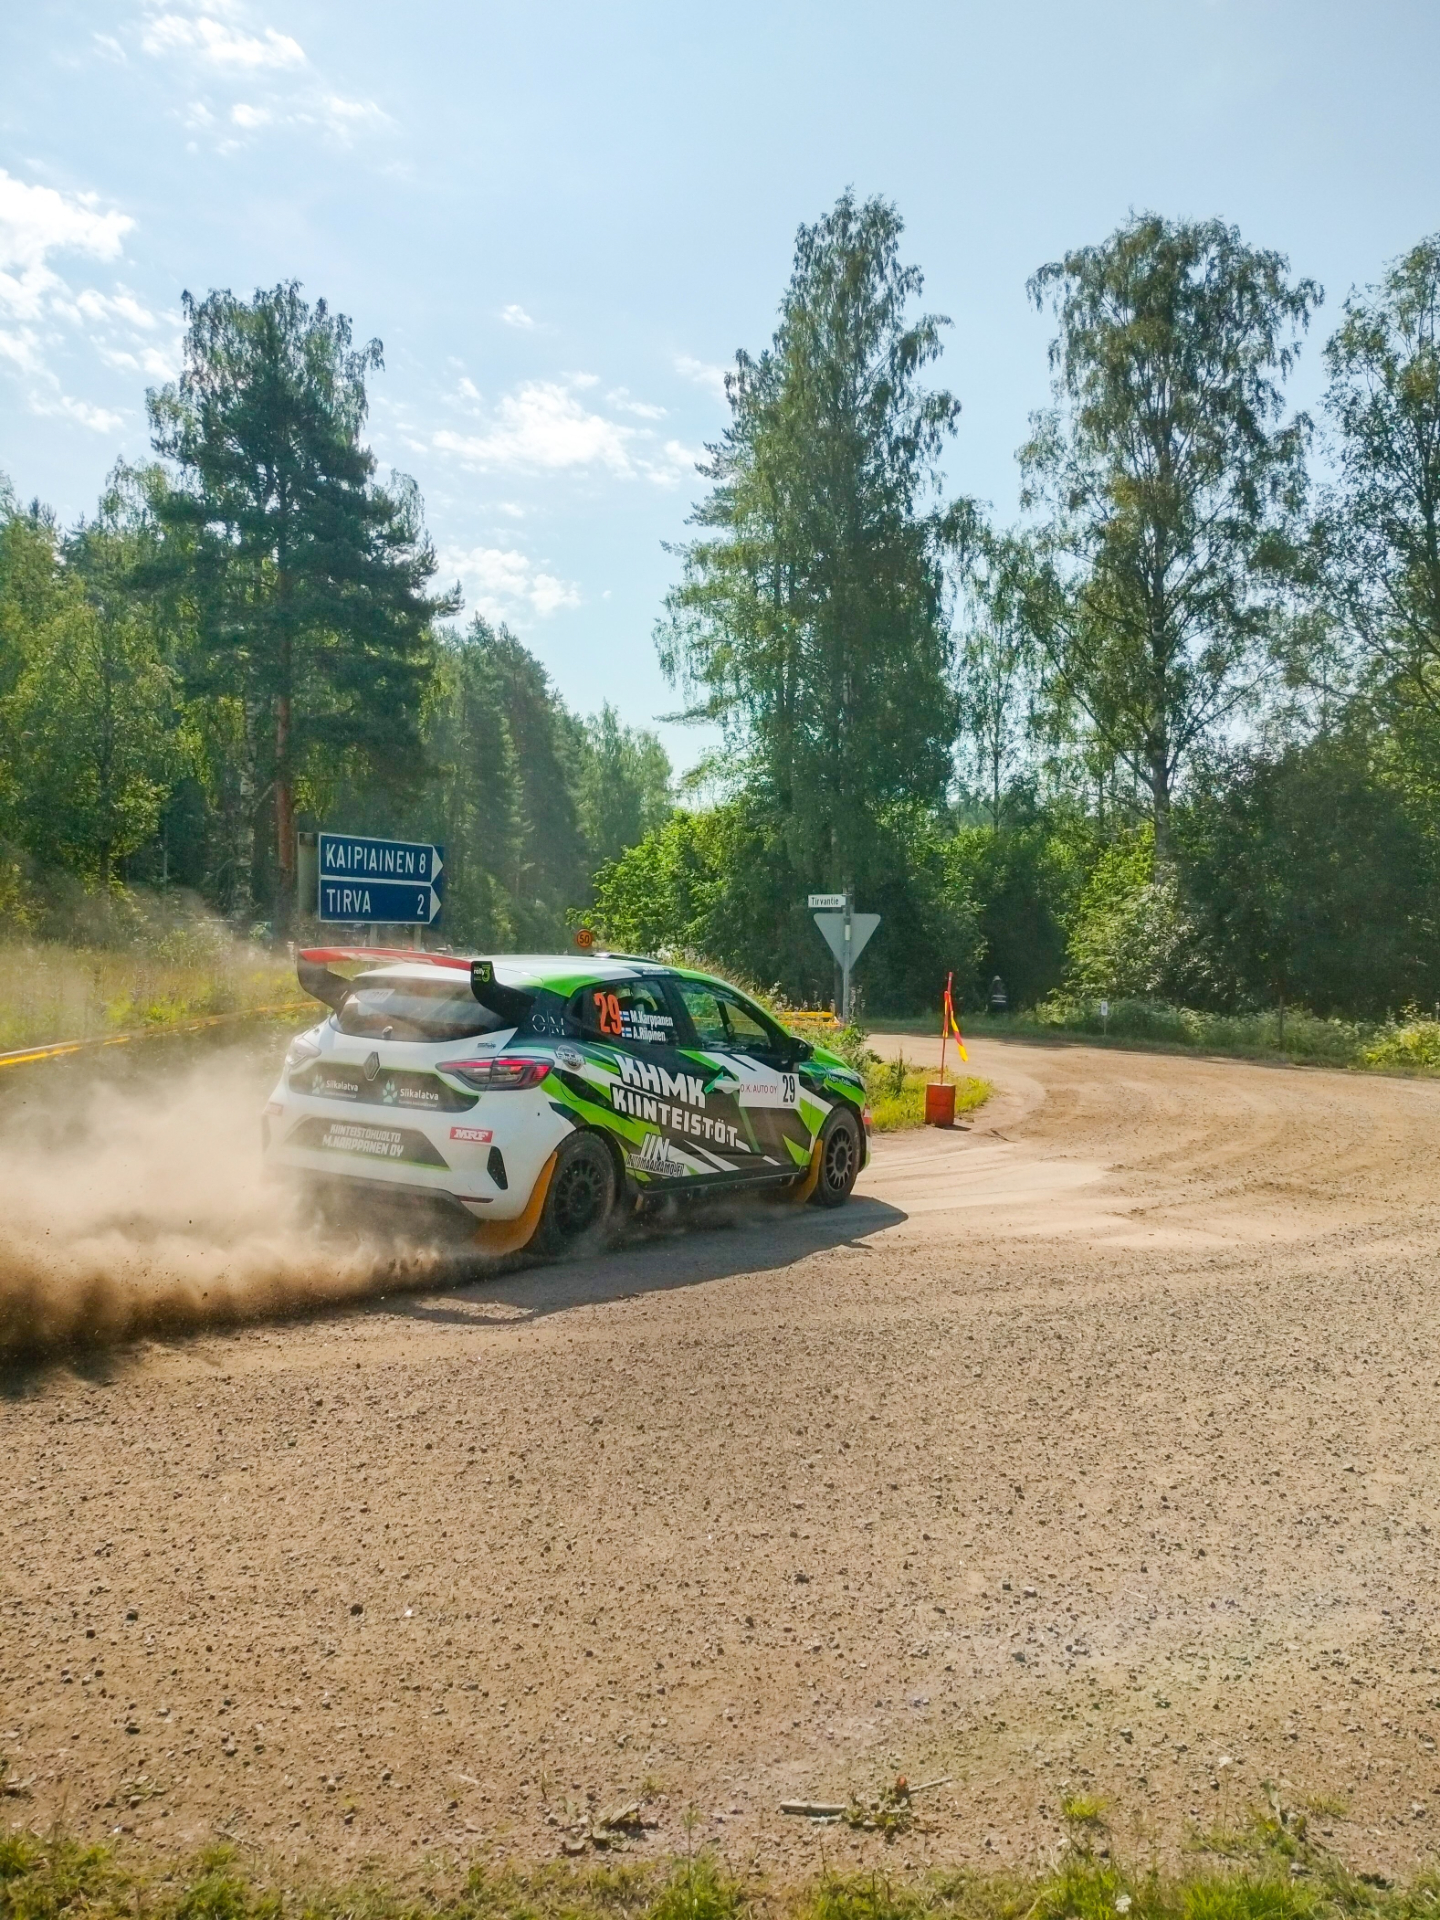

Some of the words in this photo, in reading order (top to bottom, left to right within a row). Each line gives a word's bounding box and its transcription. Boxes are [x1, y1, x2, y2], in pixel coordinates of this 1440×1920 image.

[326, 843, 415, 874] KAIPIAINEN
[418, 853, 426, 874] 8
[327, 889, 371, 913] TIRVA
[416, 894, 424, 915] 2
[811, 896, 839, 906] Tirvantie
[579, 934, 590, 944] 50
[593, 992, 622, 1035] 29
[326, 1080, 359, 1092] Siikalatva
[613, 1054, 706, 1109] KHMK
[400, 1088, 439, 1101] Siikalatva
[753, 1084, 769, 1094] AUTO
[769, 1085, 778, 1094] OY
[782, 1074, 796, 1103] 29
[612, 1086, 738, 1148] KIINTEISTÖT
[454, 1129, 489, 1141] MRF
[389, 1144, 404, 1157] OY
